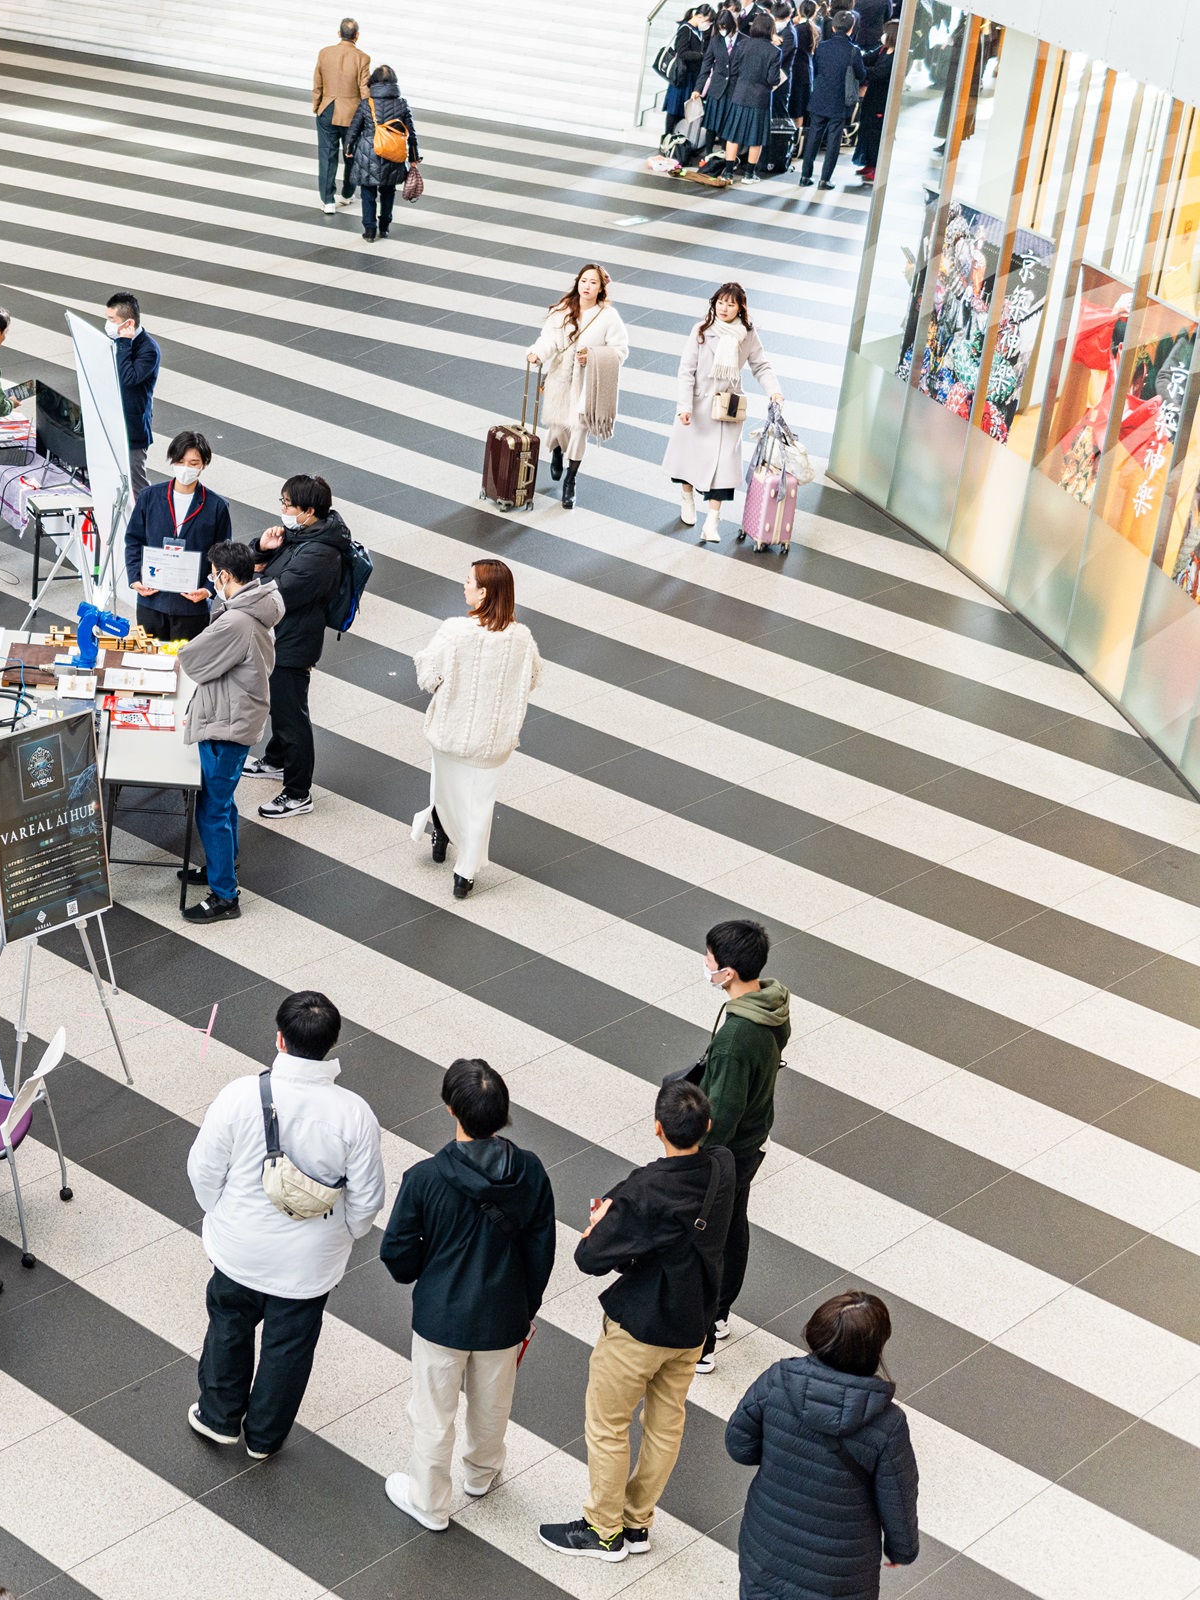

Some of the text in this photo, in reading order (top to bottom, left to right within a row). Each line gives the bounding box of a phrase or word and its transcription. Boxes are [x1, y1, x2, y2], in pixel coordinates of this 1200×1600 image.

[986, 249, 1041, 394] 京築神楽
[1132, 361, 1189, 519] 京築神楽
[0, 818, 54, 846] VAREAL
[56, 811, 68, 827] AI
[70, 803, 96, 822] HUB
[34, 922, 52, 932] VAREAL
